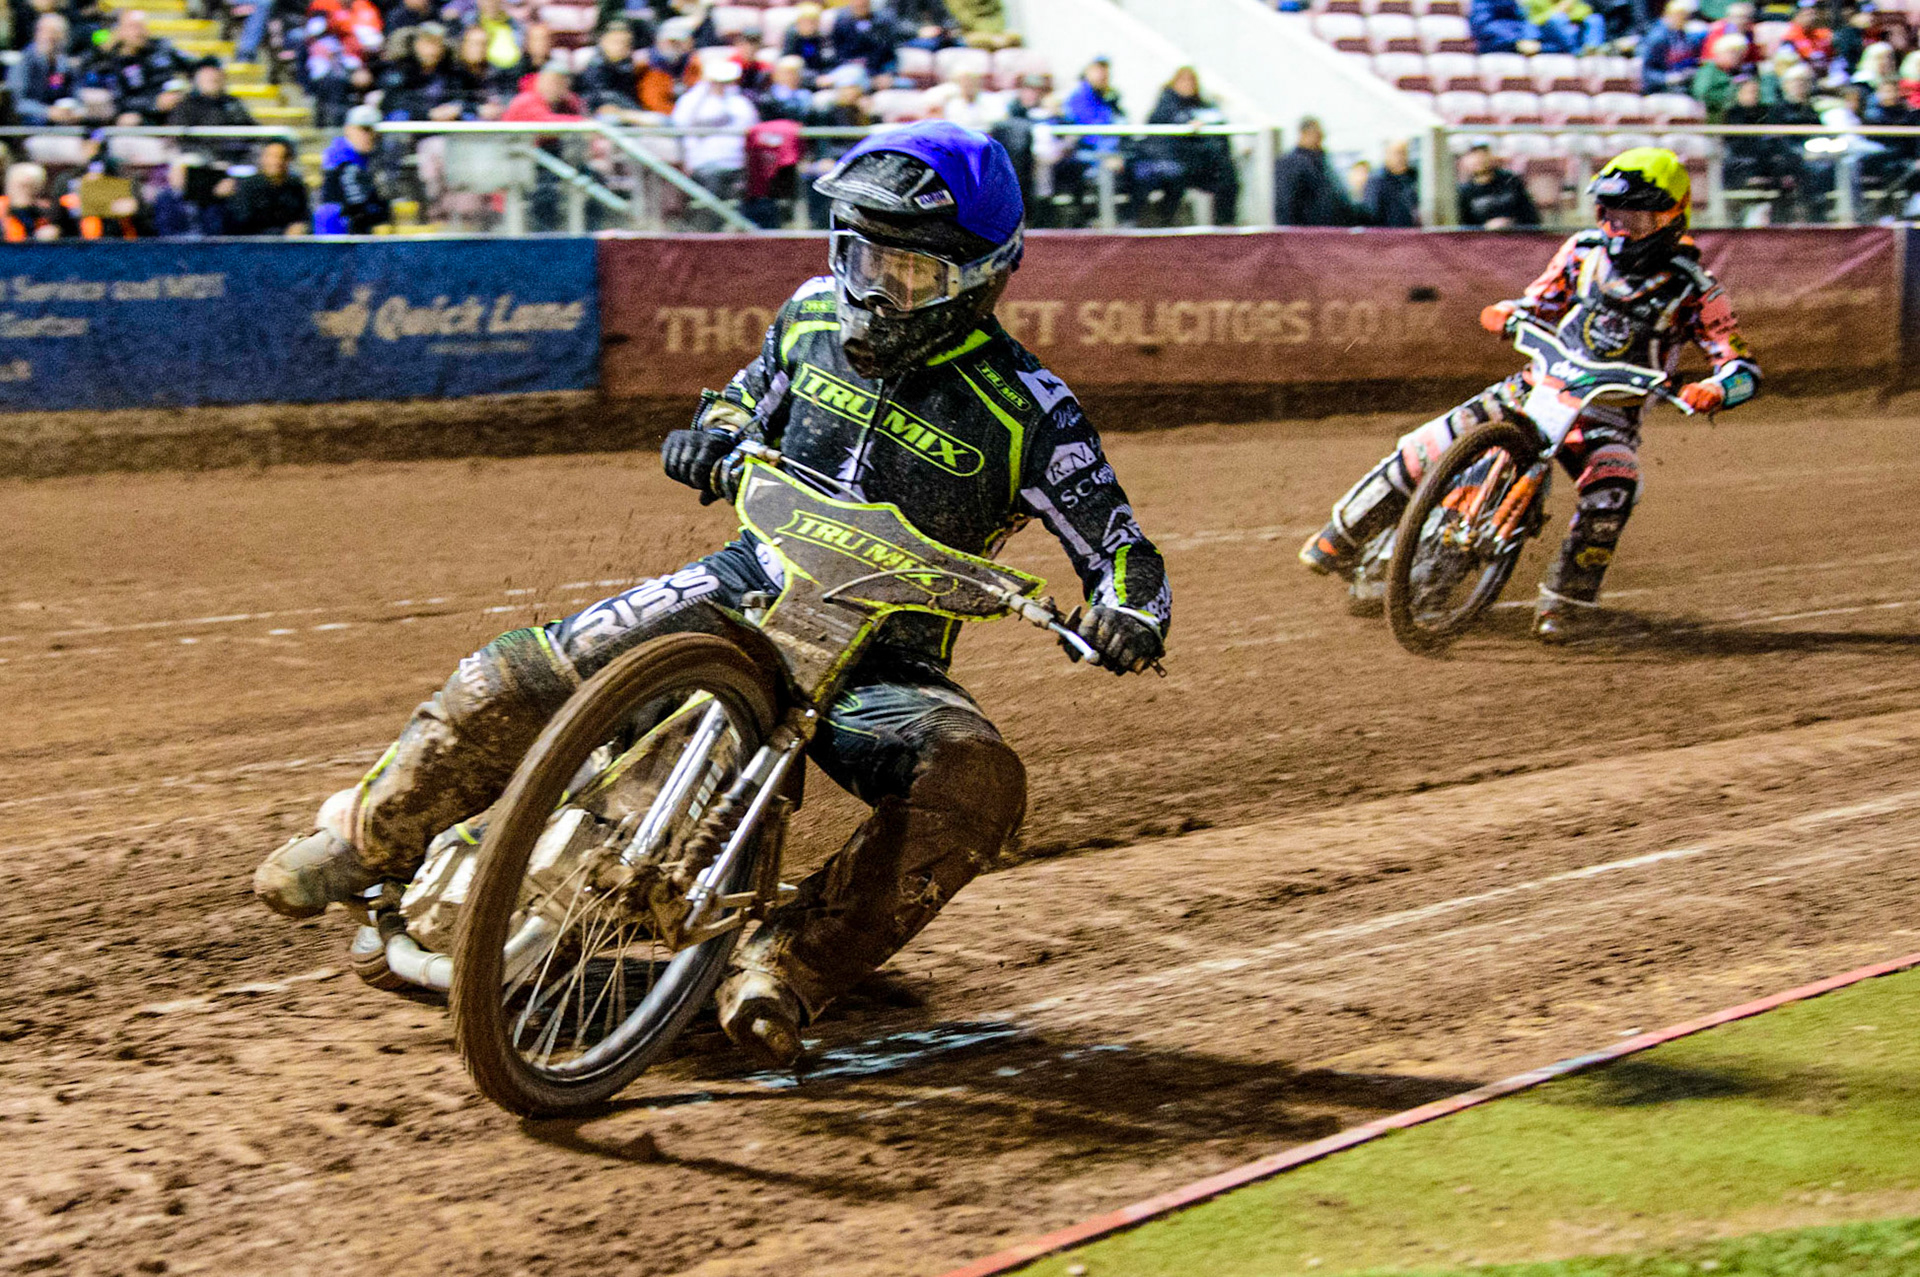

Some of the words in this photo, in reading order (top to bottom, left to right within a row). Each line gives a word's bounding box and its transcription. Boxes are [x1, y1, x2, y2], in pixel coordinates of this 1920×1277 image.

[1078, 300, 1312, 345] SOLICITORS
[882, 410, 968, 469] MIX
[796, 517, 867, 550] TRU
